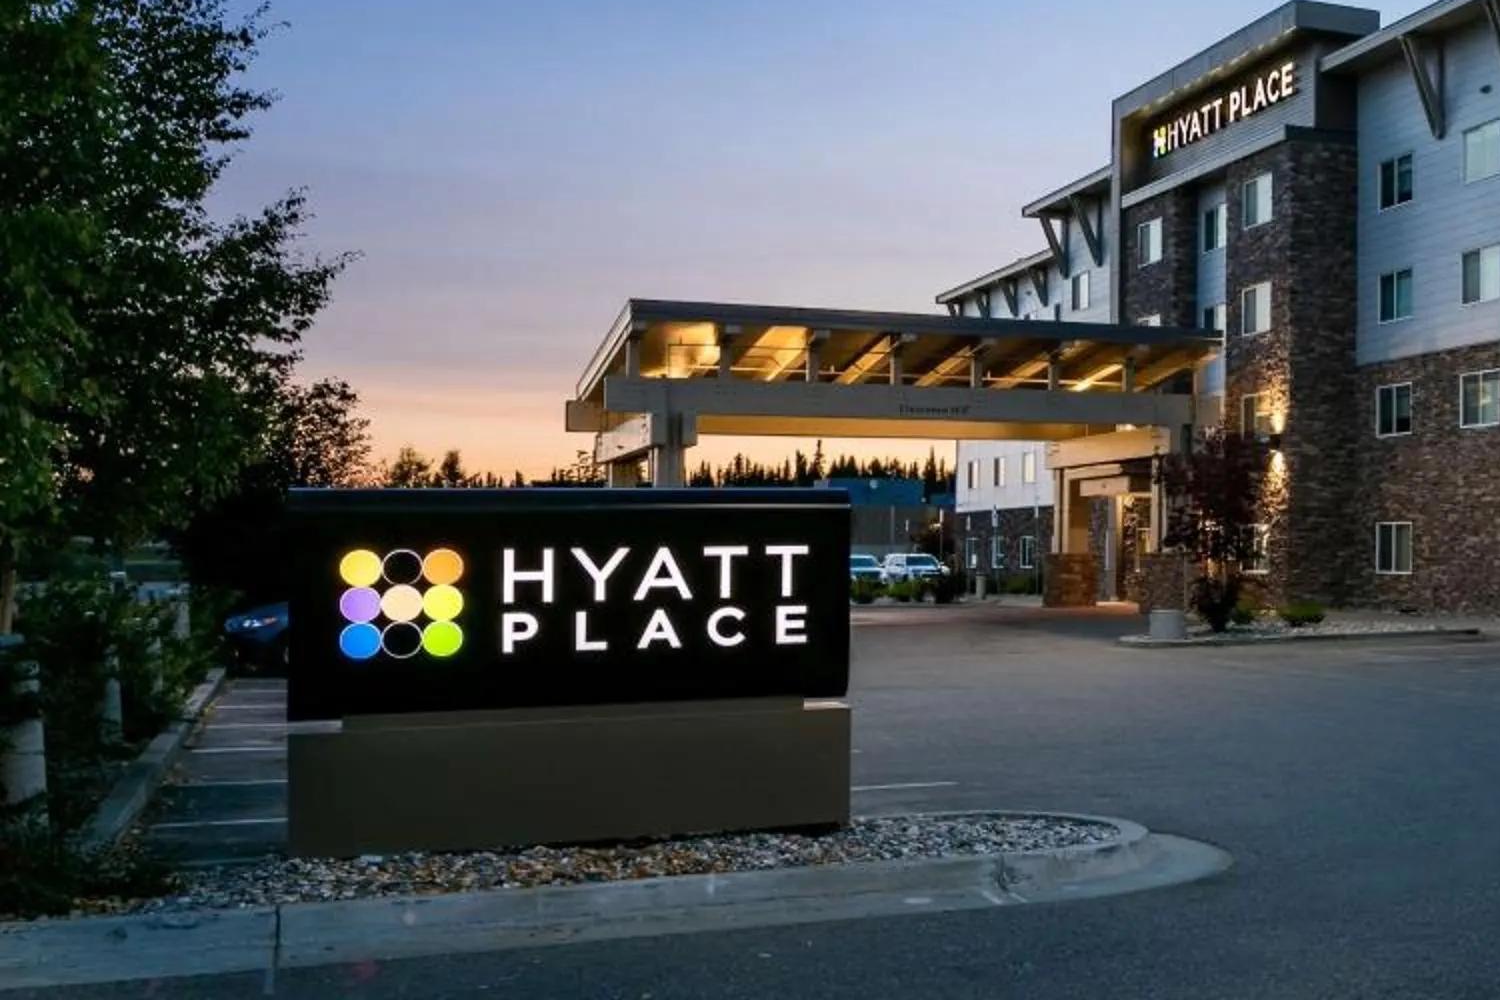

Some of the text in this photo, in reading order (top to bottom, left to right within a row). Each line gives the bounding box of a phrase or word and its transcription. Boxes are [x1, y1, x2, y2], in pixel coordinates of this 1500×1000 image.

[1166, 61, 1295, 152] HYATT PLACE
[502, 545, 809, 604] HYATT
[502, 605, 808, 654] PLACE
